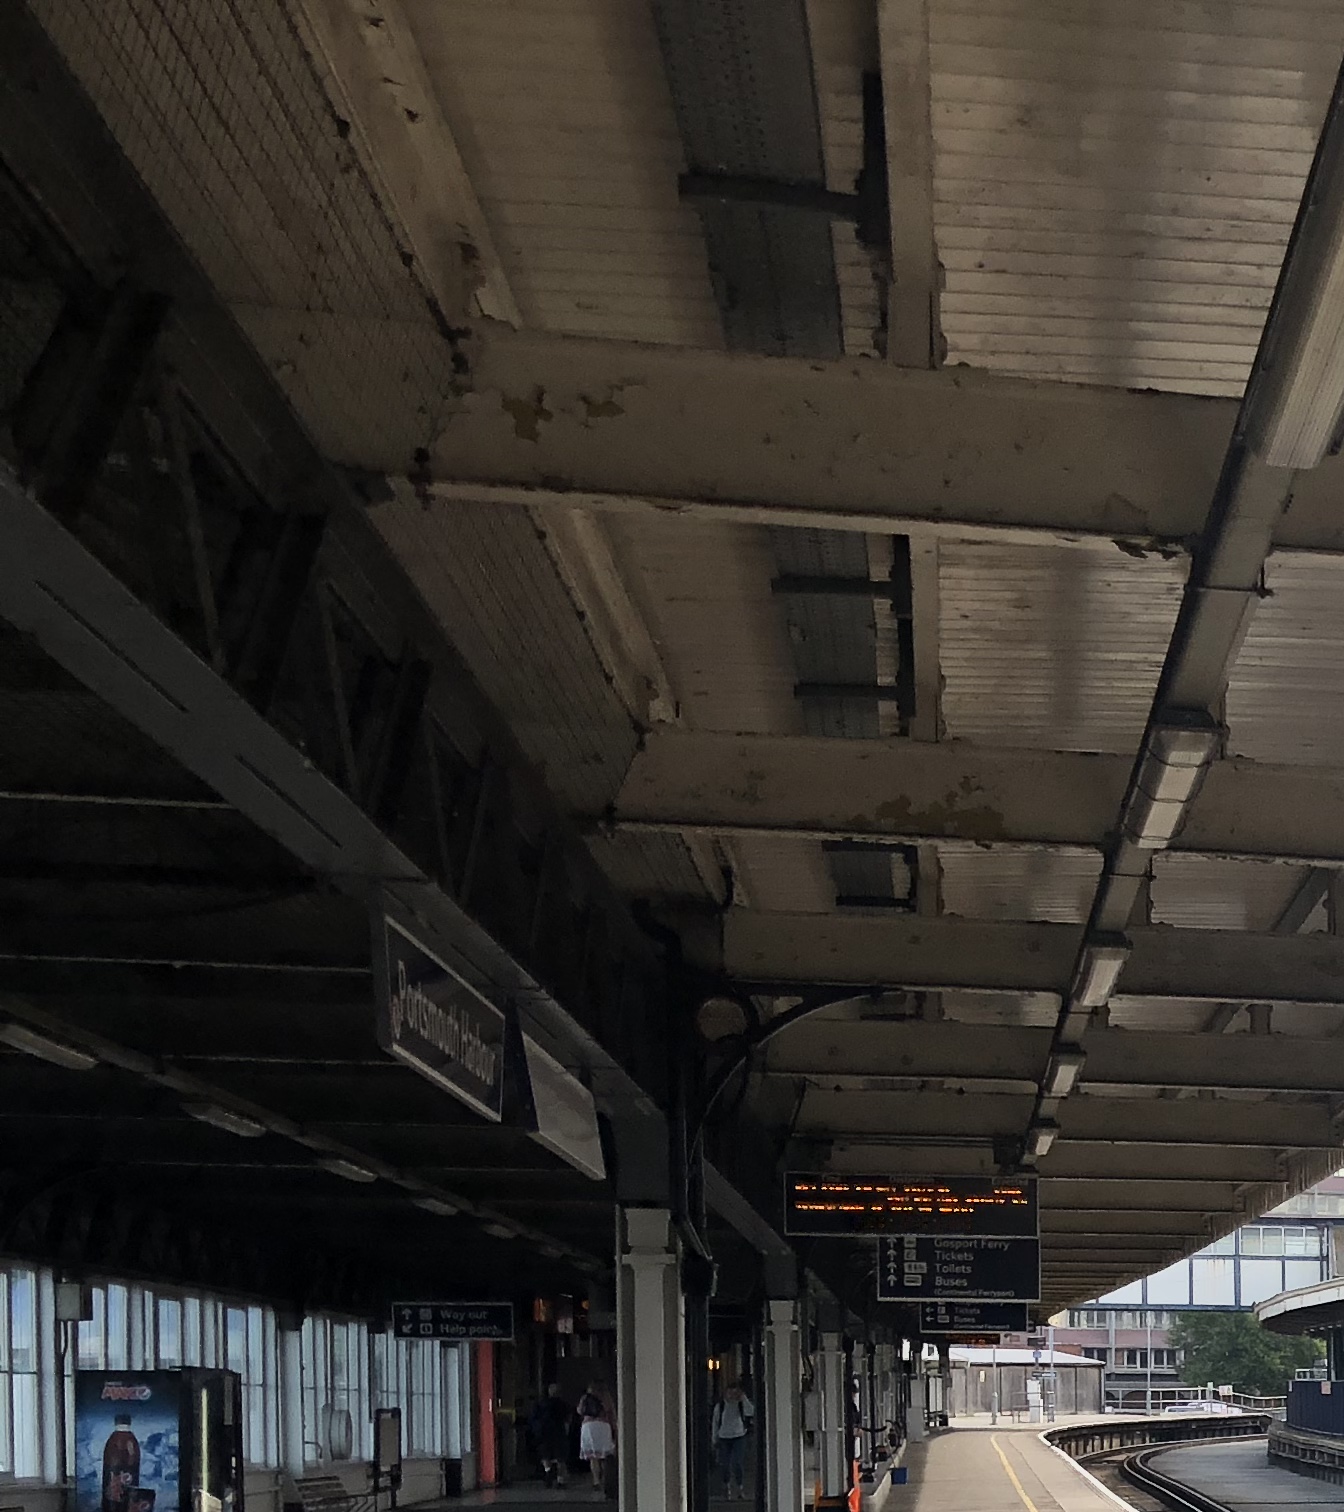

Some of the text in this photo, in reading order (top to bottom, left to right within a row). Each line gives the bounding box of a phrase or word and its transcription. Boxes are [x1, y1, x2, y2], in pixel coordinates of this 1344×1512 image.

[398, 959, 496, 1086] Portsmouth Harbour
[934, 1238, 1011, 1251] Gosport Ferry
[934, 1250, 975, 1261] Tickets
[935, 1263, 973, 1274] Toilets
[935, 1276, 968, 1287] Buses
[440, 1309, 488, 1321] Way out
[440, 1323, 467, 1334] Help
